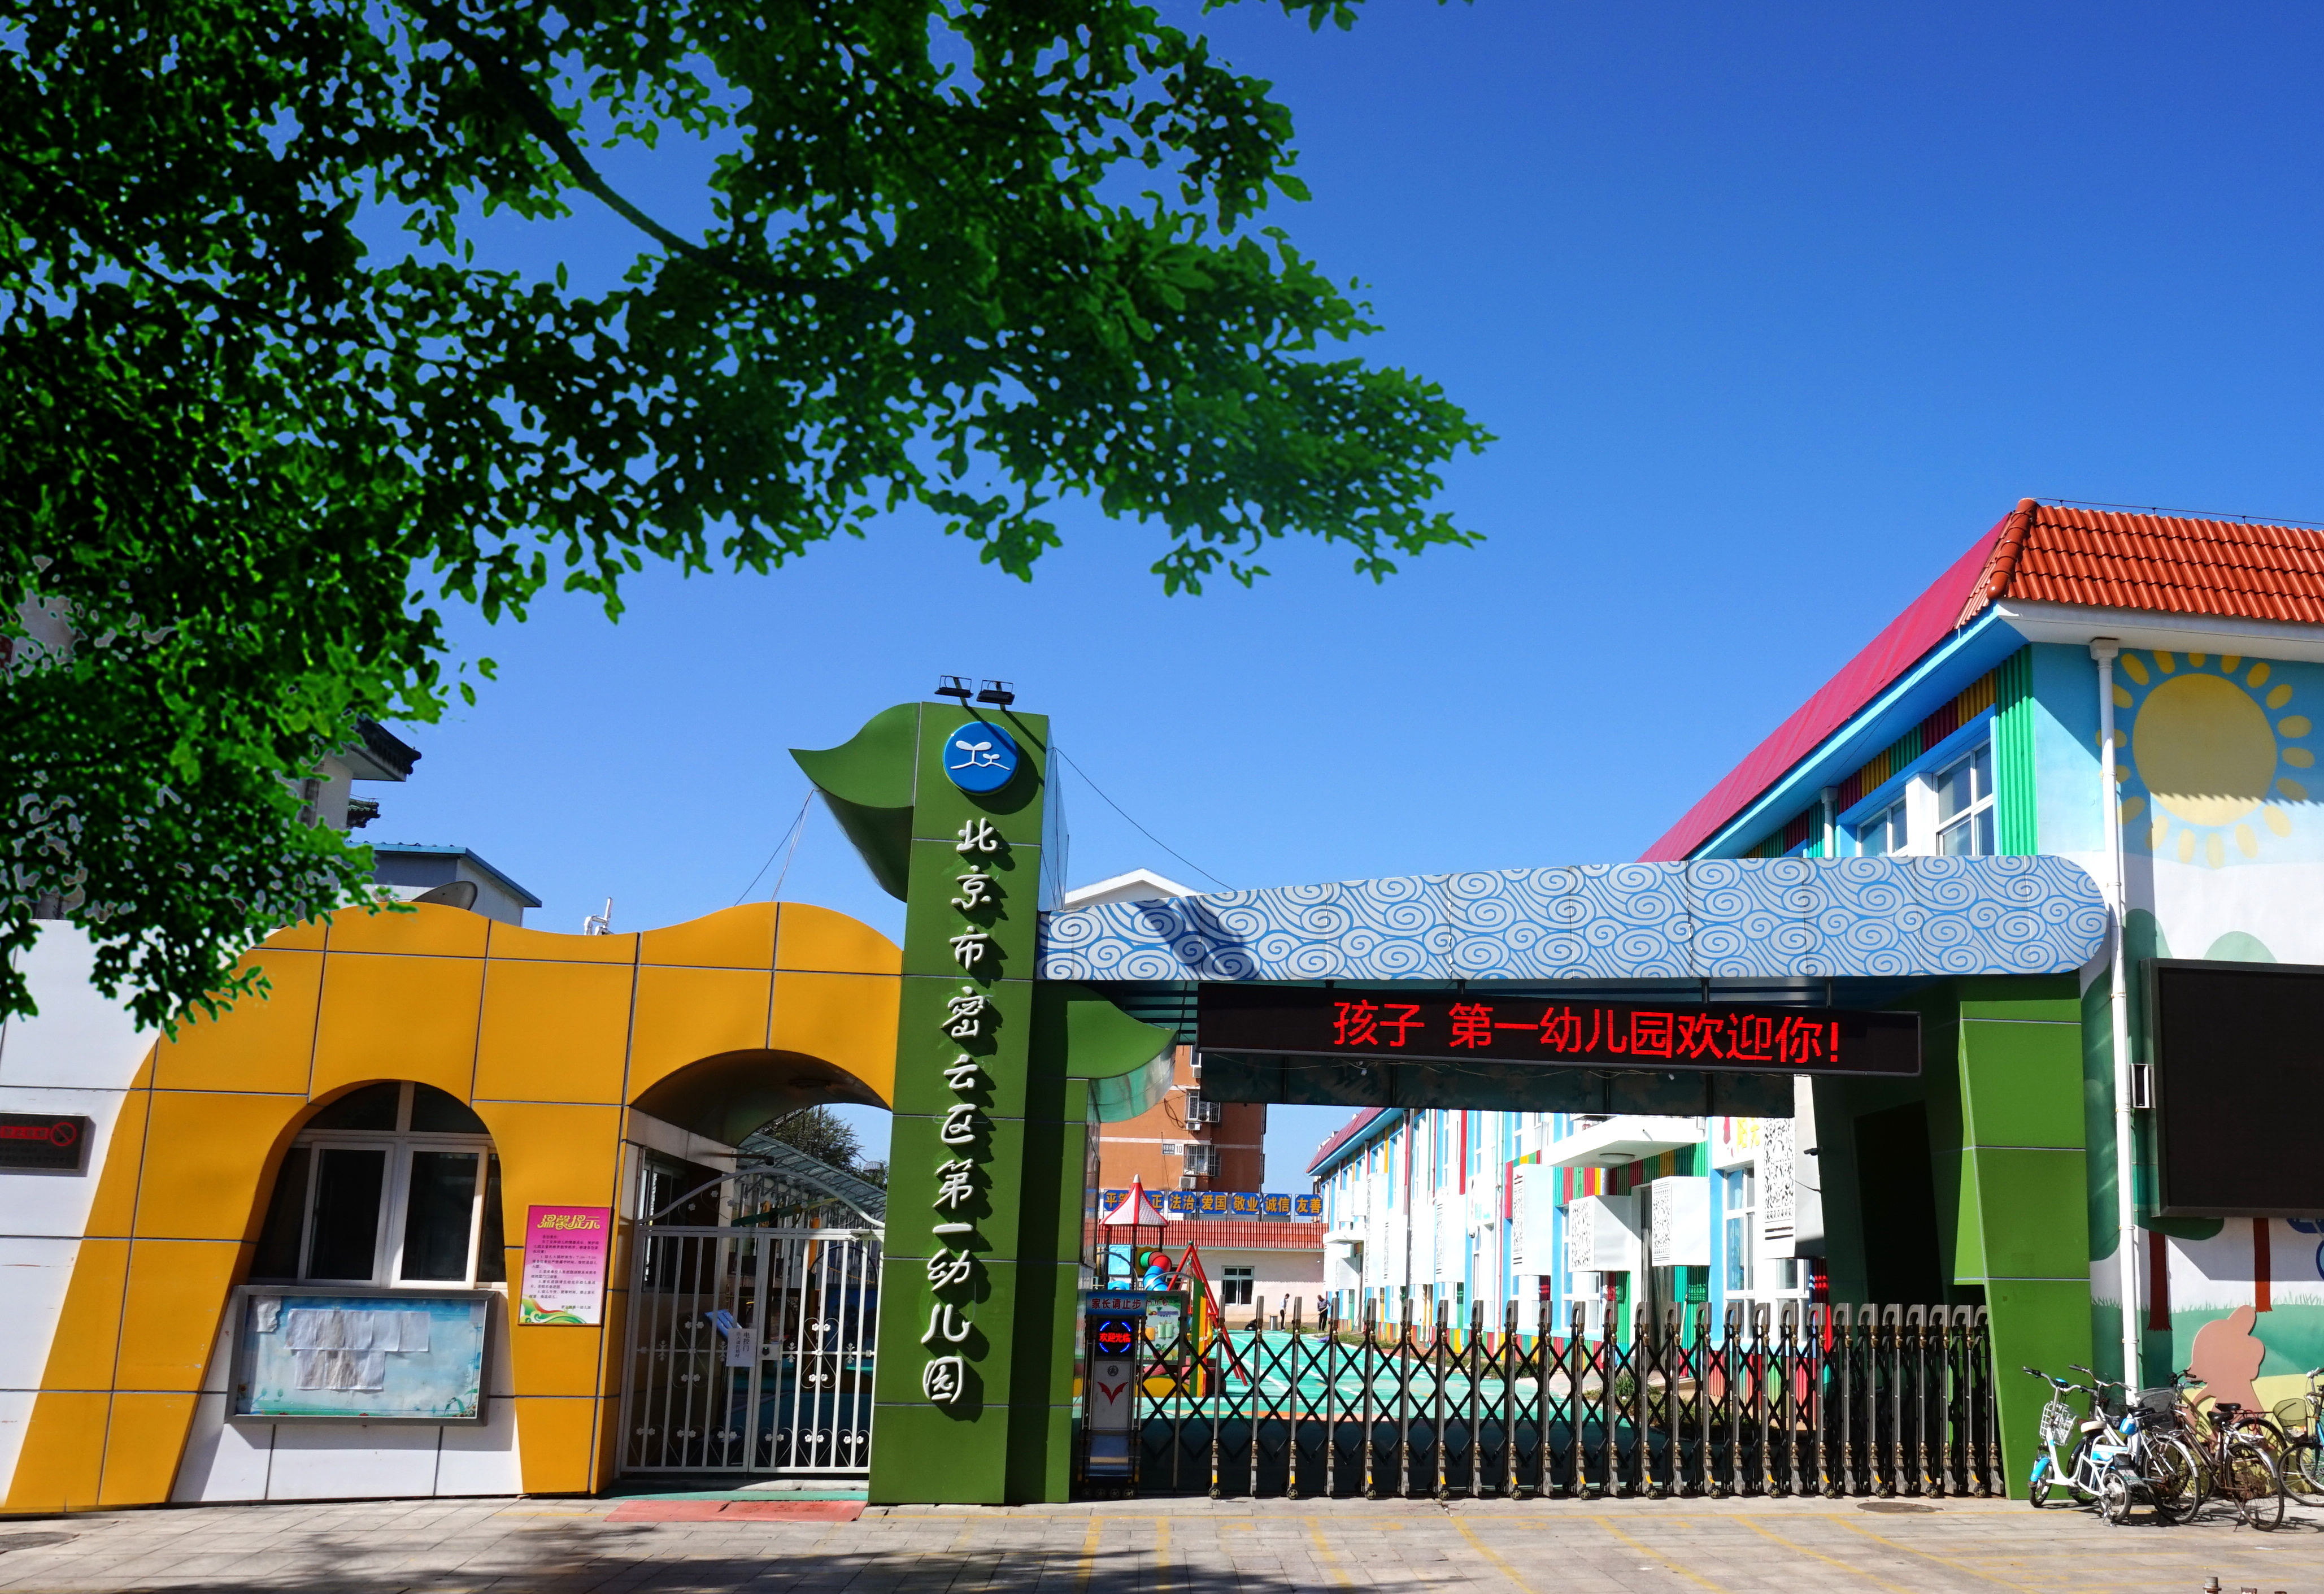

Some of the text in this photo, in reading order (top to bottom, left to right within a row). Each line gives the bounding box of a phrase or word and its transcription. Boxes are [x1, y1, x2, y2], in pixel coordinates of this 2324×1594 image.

[1333, 999, 1425, 1047] 孩子
[921, 817, 999, 1404] 北京市密云区第一幼儿园
[1169, 1195, 1195, 1210] 法治
[1201, 1195, 1226, 1211] 爱国
[1233, 1196, 1259, 1211] 敬业
[1265, 1197, 1290, 1213] 诚信
[1296, 1198, 1322, 1214] 友善
[537, 1214, 600, 1230] 温馨提示
[1091, 1298, 1141, 1310] 家长请止步
[1099, 1332, 1131, 1343] 欢迎光临
